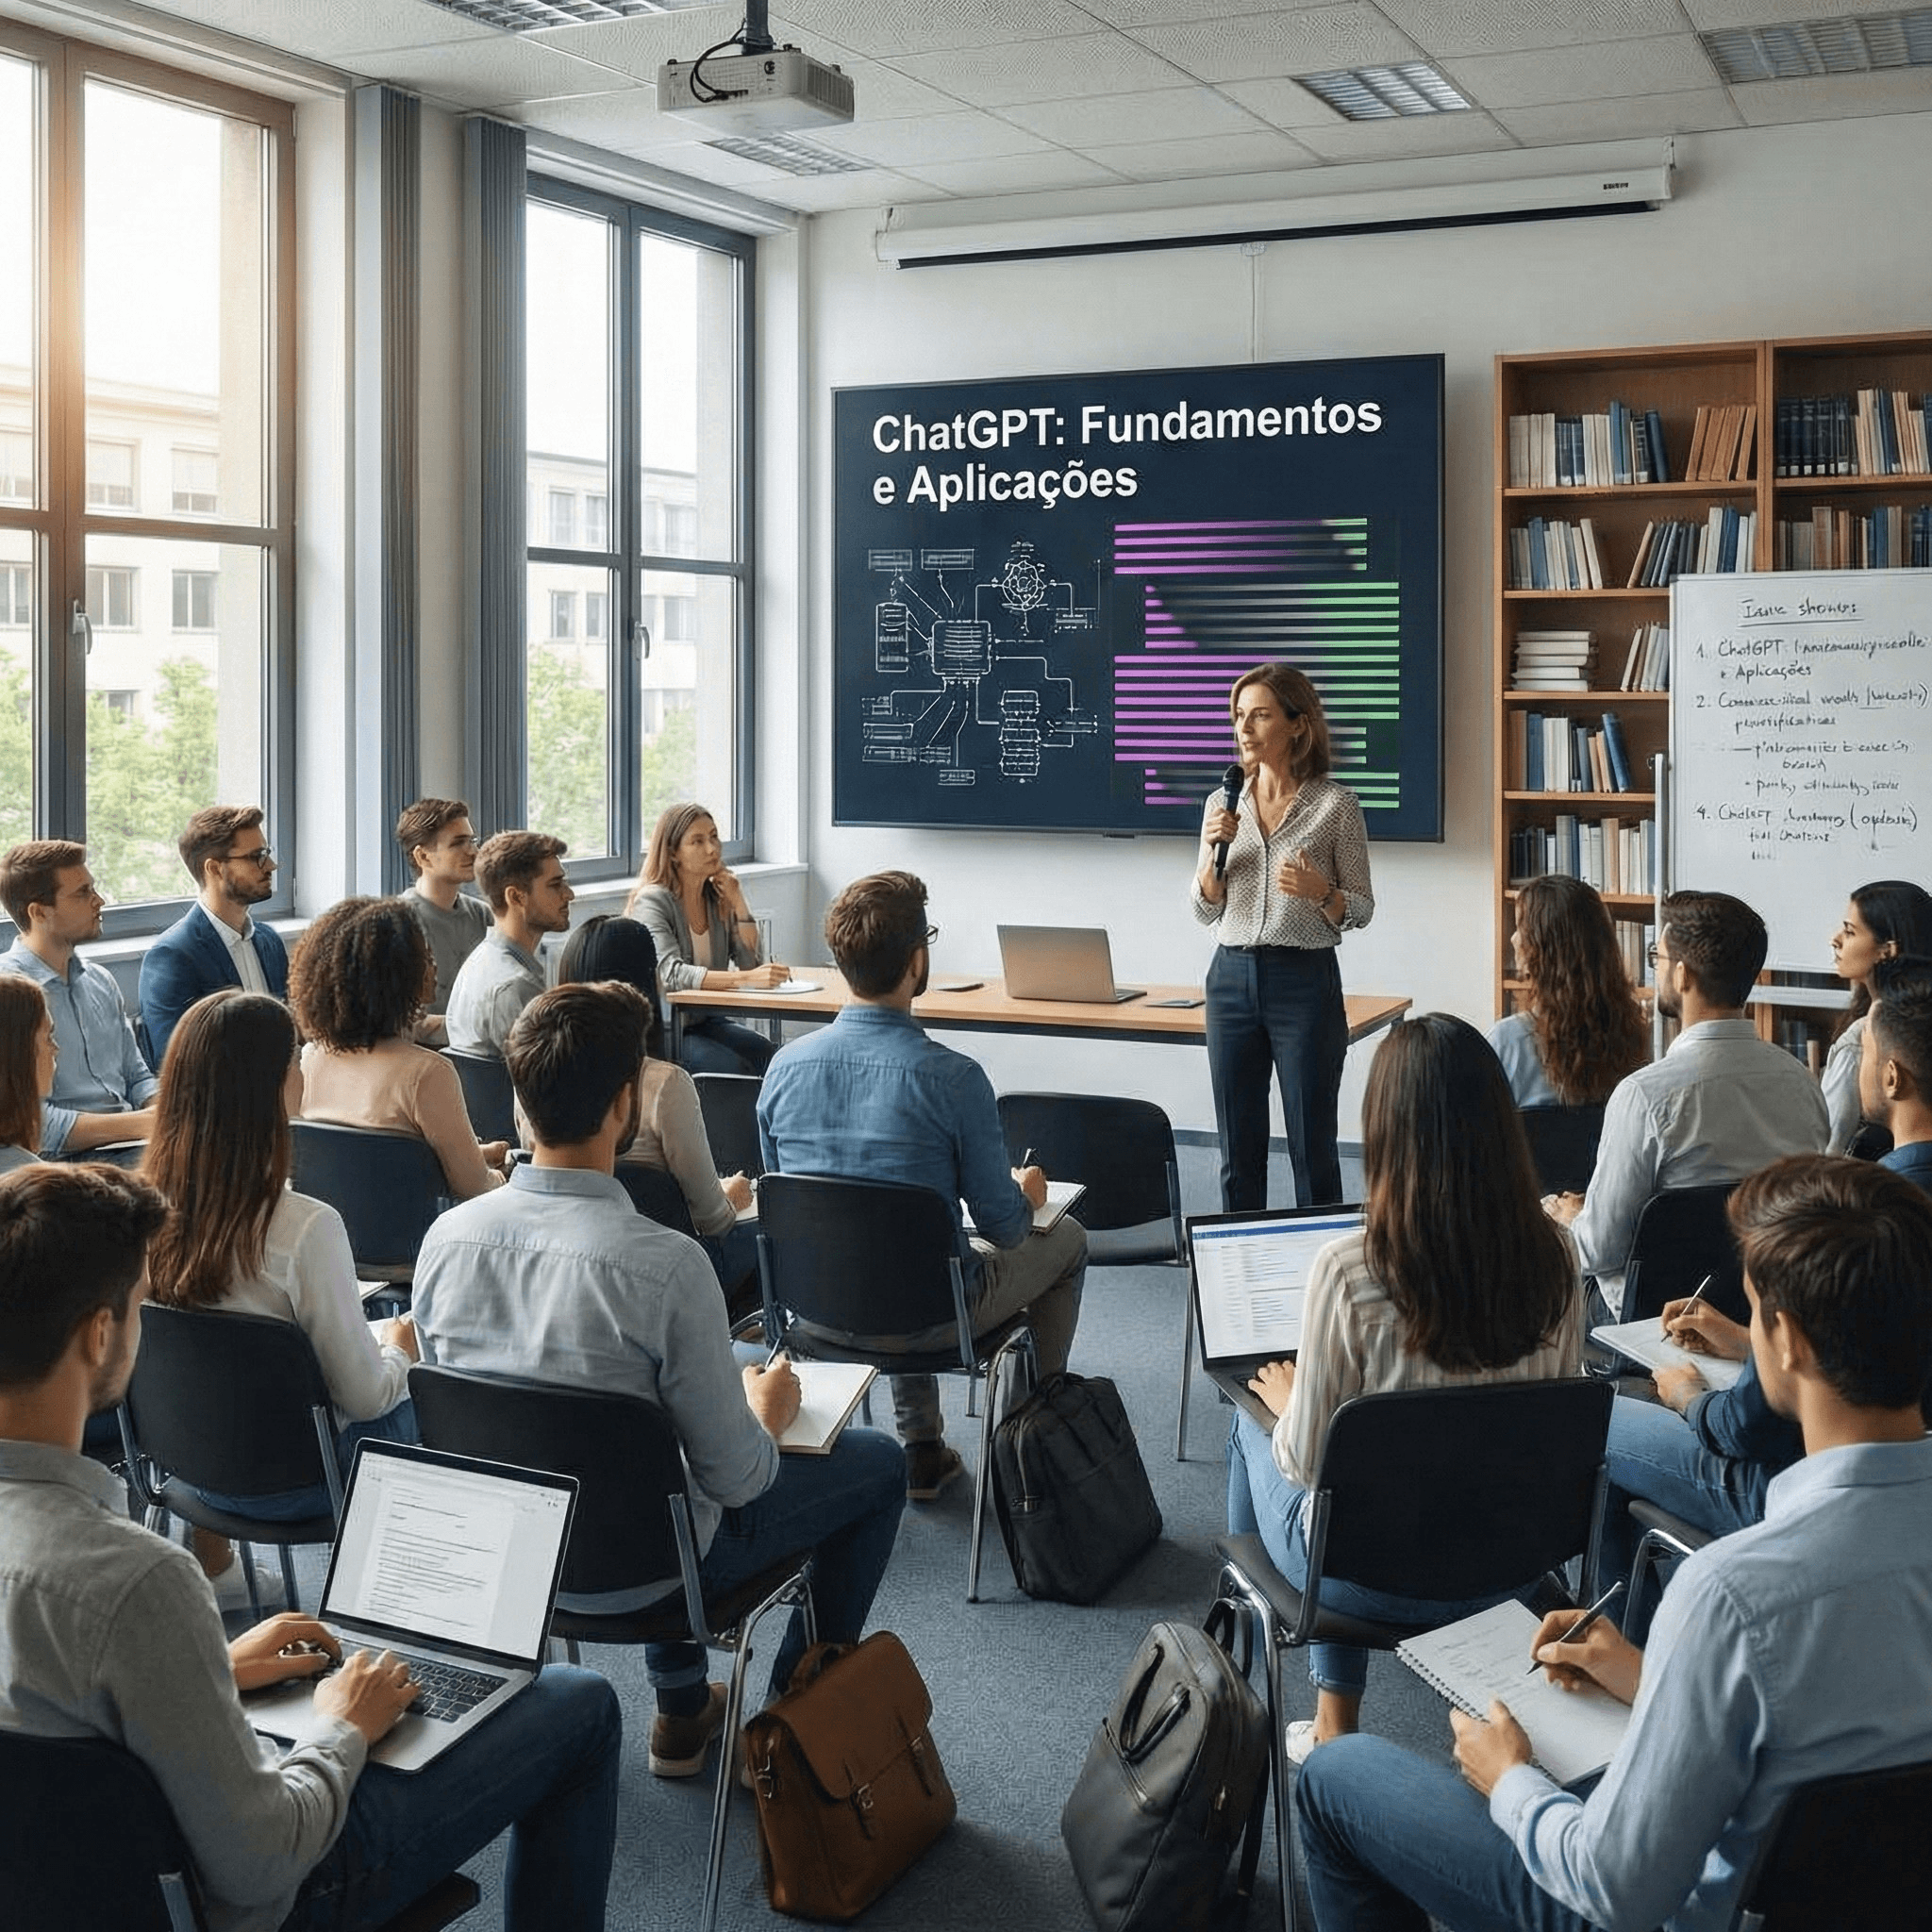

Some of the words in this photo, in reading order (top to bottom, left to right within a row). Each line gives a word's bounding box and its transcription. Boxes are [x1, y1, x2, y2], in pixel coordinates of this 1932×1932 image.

[873, 408, 1064, 453] ChatGPT:
[1081, 396, 1382, 444] Fundamentos
[873, 475, 895, 506] e
[907, 458, 1138, 512] Aplicações
[1718, 638, 1784, 657] ChatGPT
[1736, 659, 1811, 684] Aplicações
